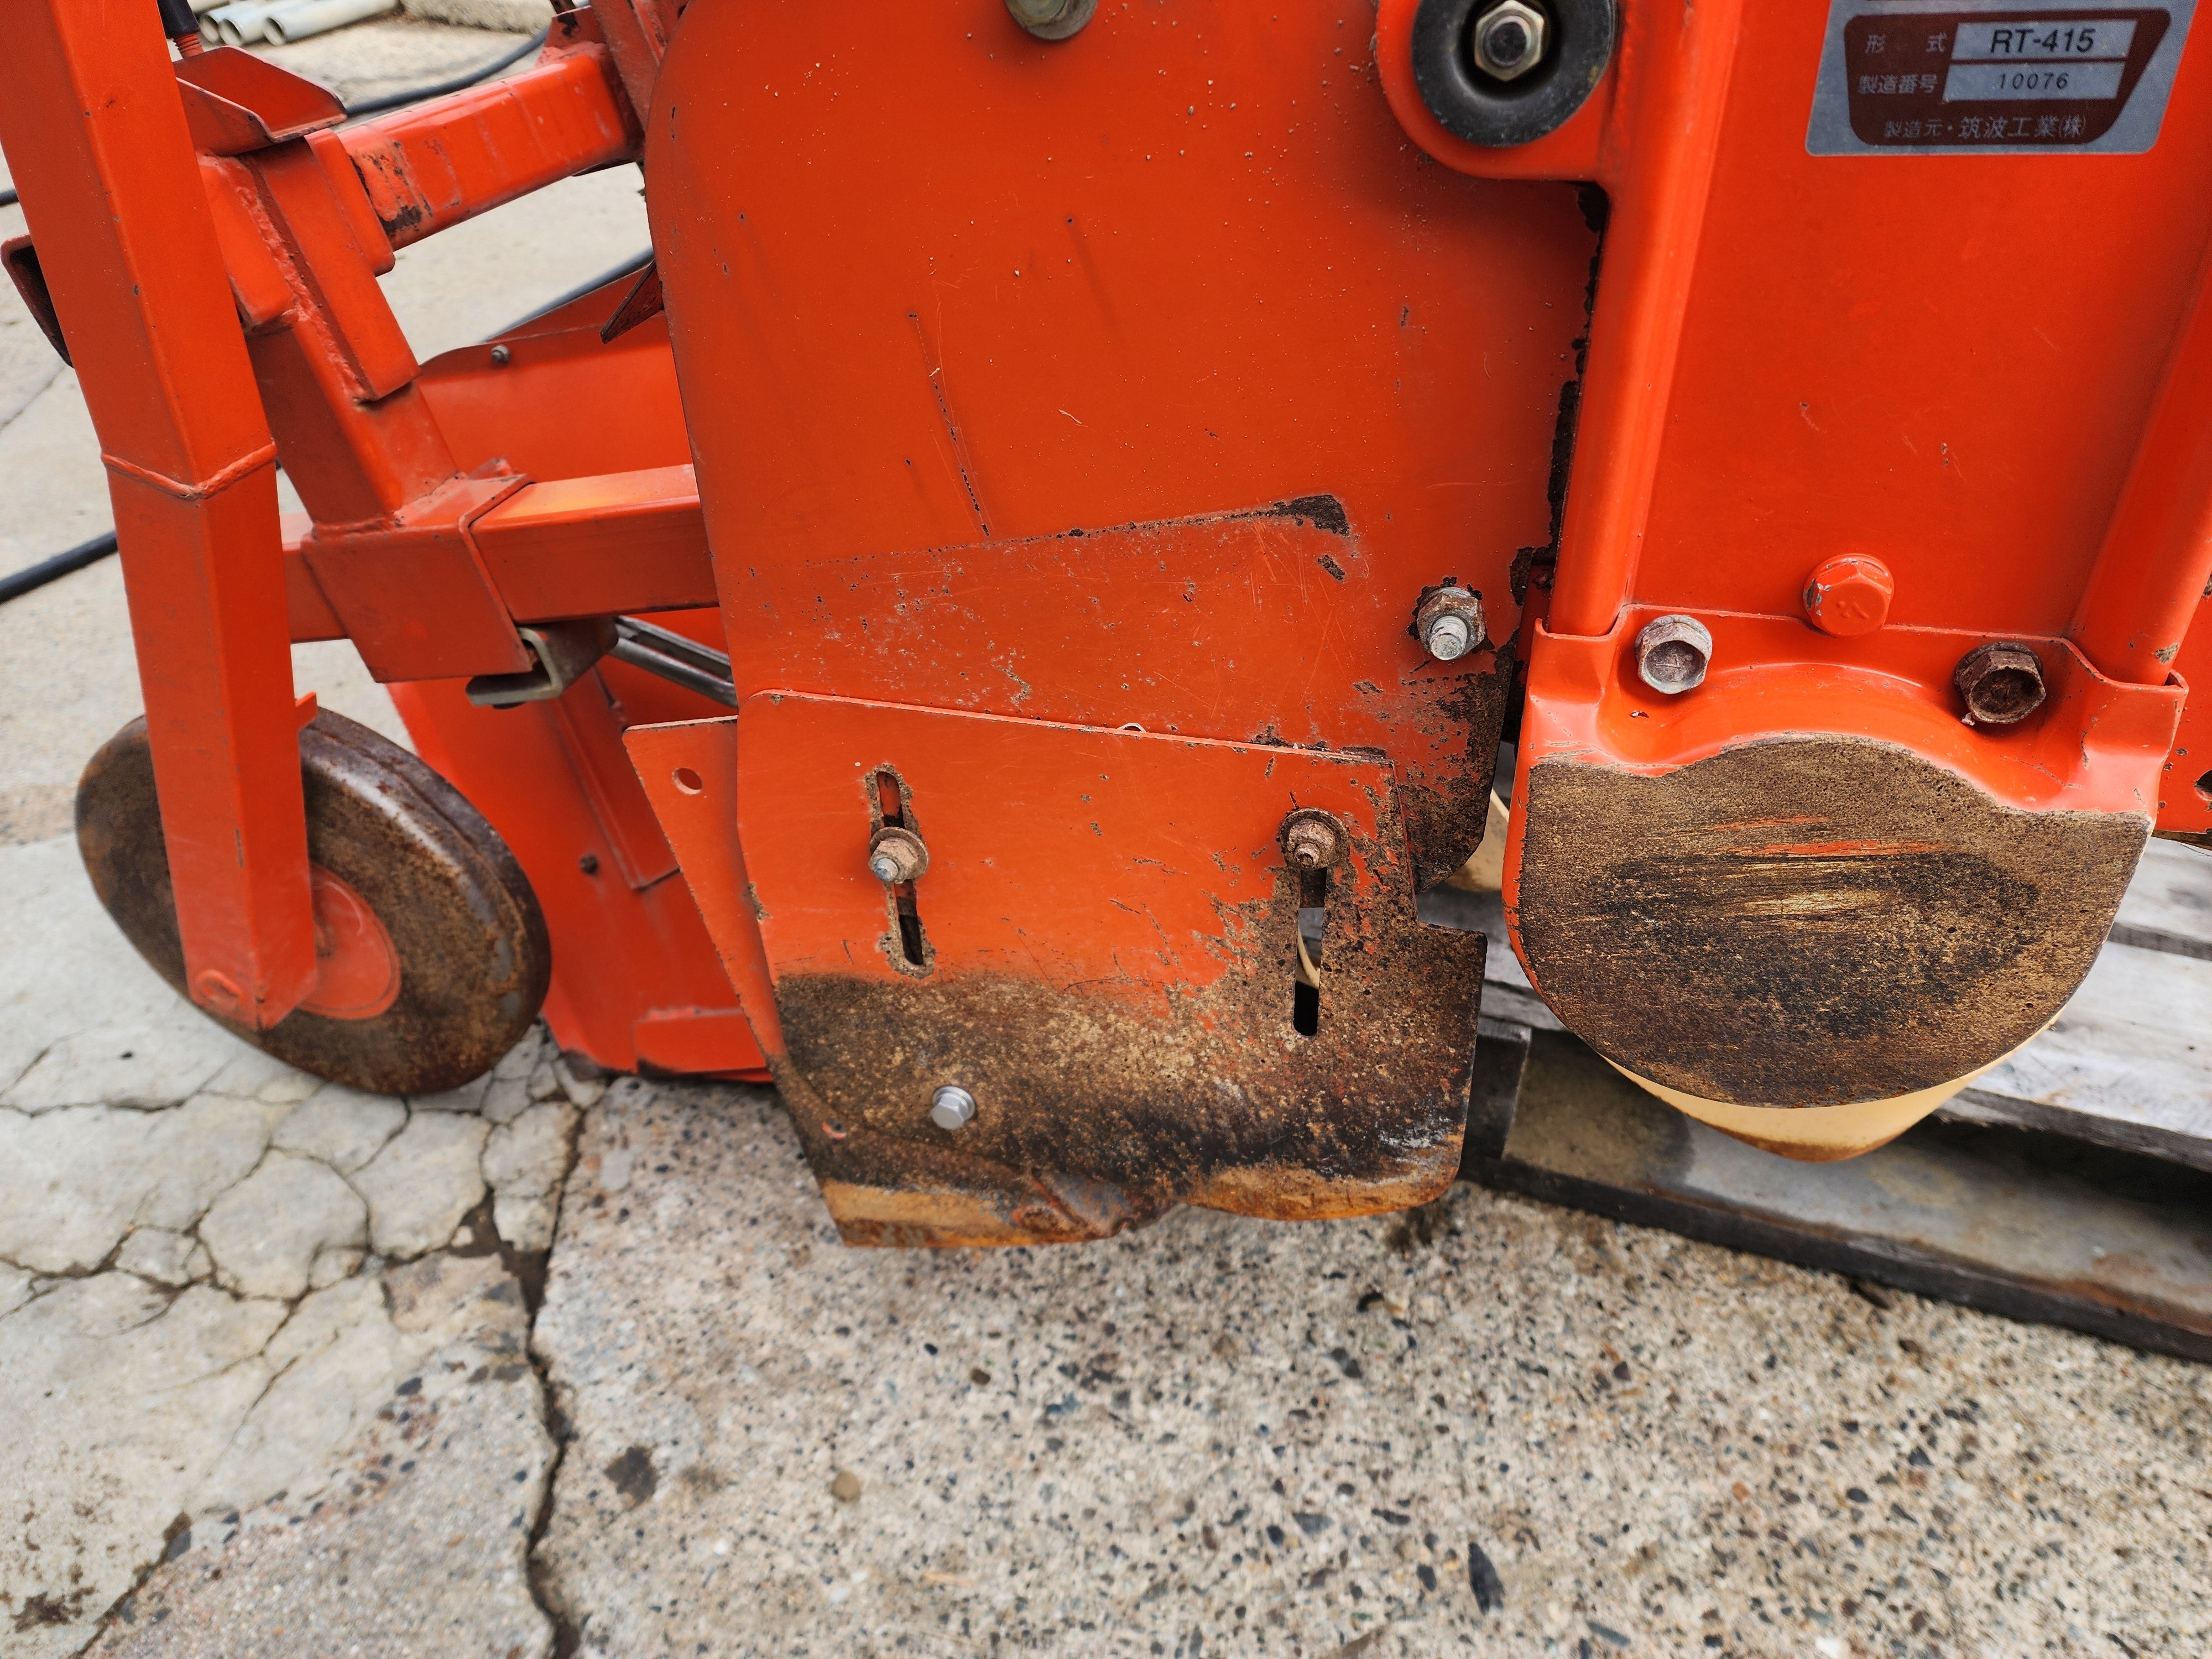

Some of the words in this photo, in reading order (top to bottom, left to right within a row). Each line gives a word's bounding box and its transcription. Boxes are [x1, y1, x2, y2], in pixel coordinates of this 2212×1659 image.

[1991, 28, 2095, 53] RT-415
[1859, 75, 1938, 95] 製造番号
[1999, 72, 2069, 91] 10076
